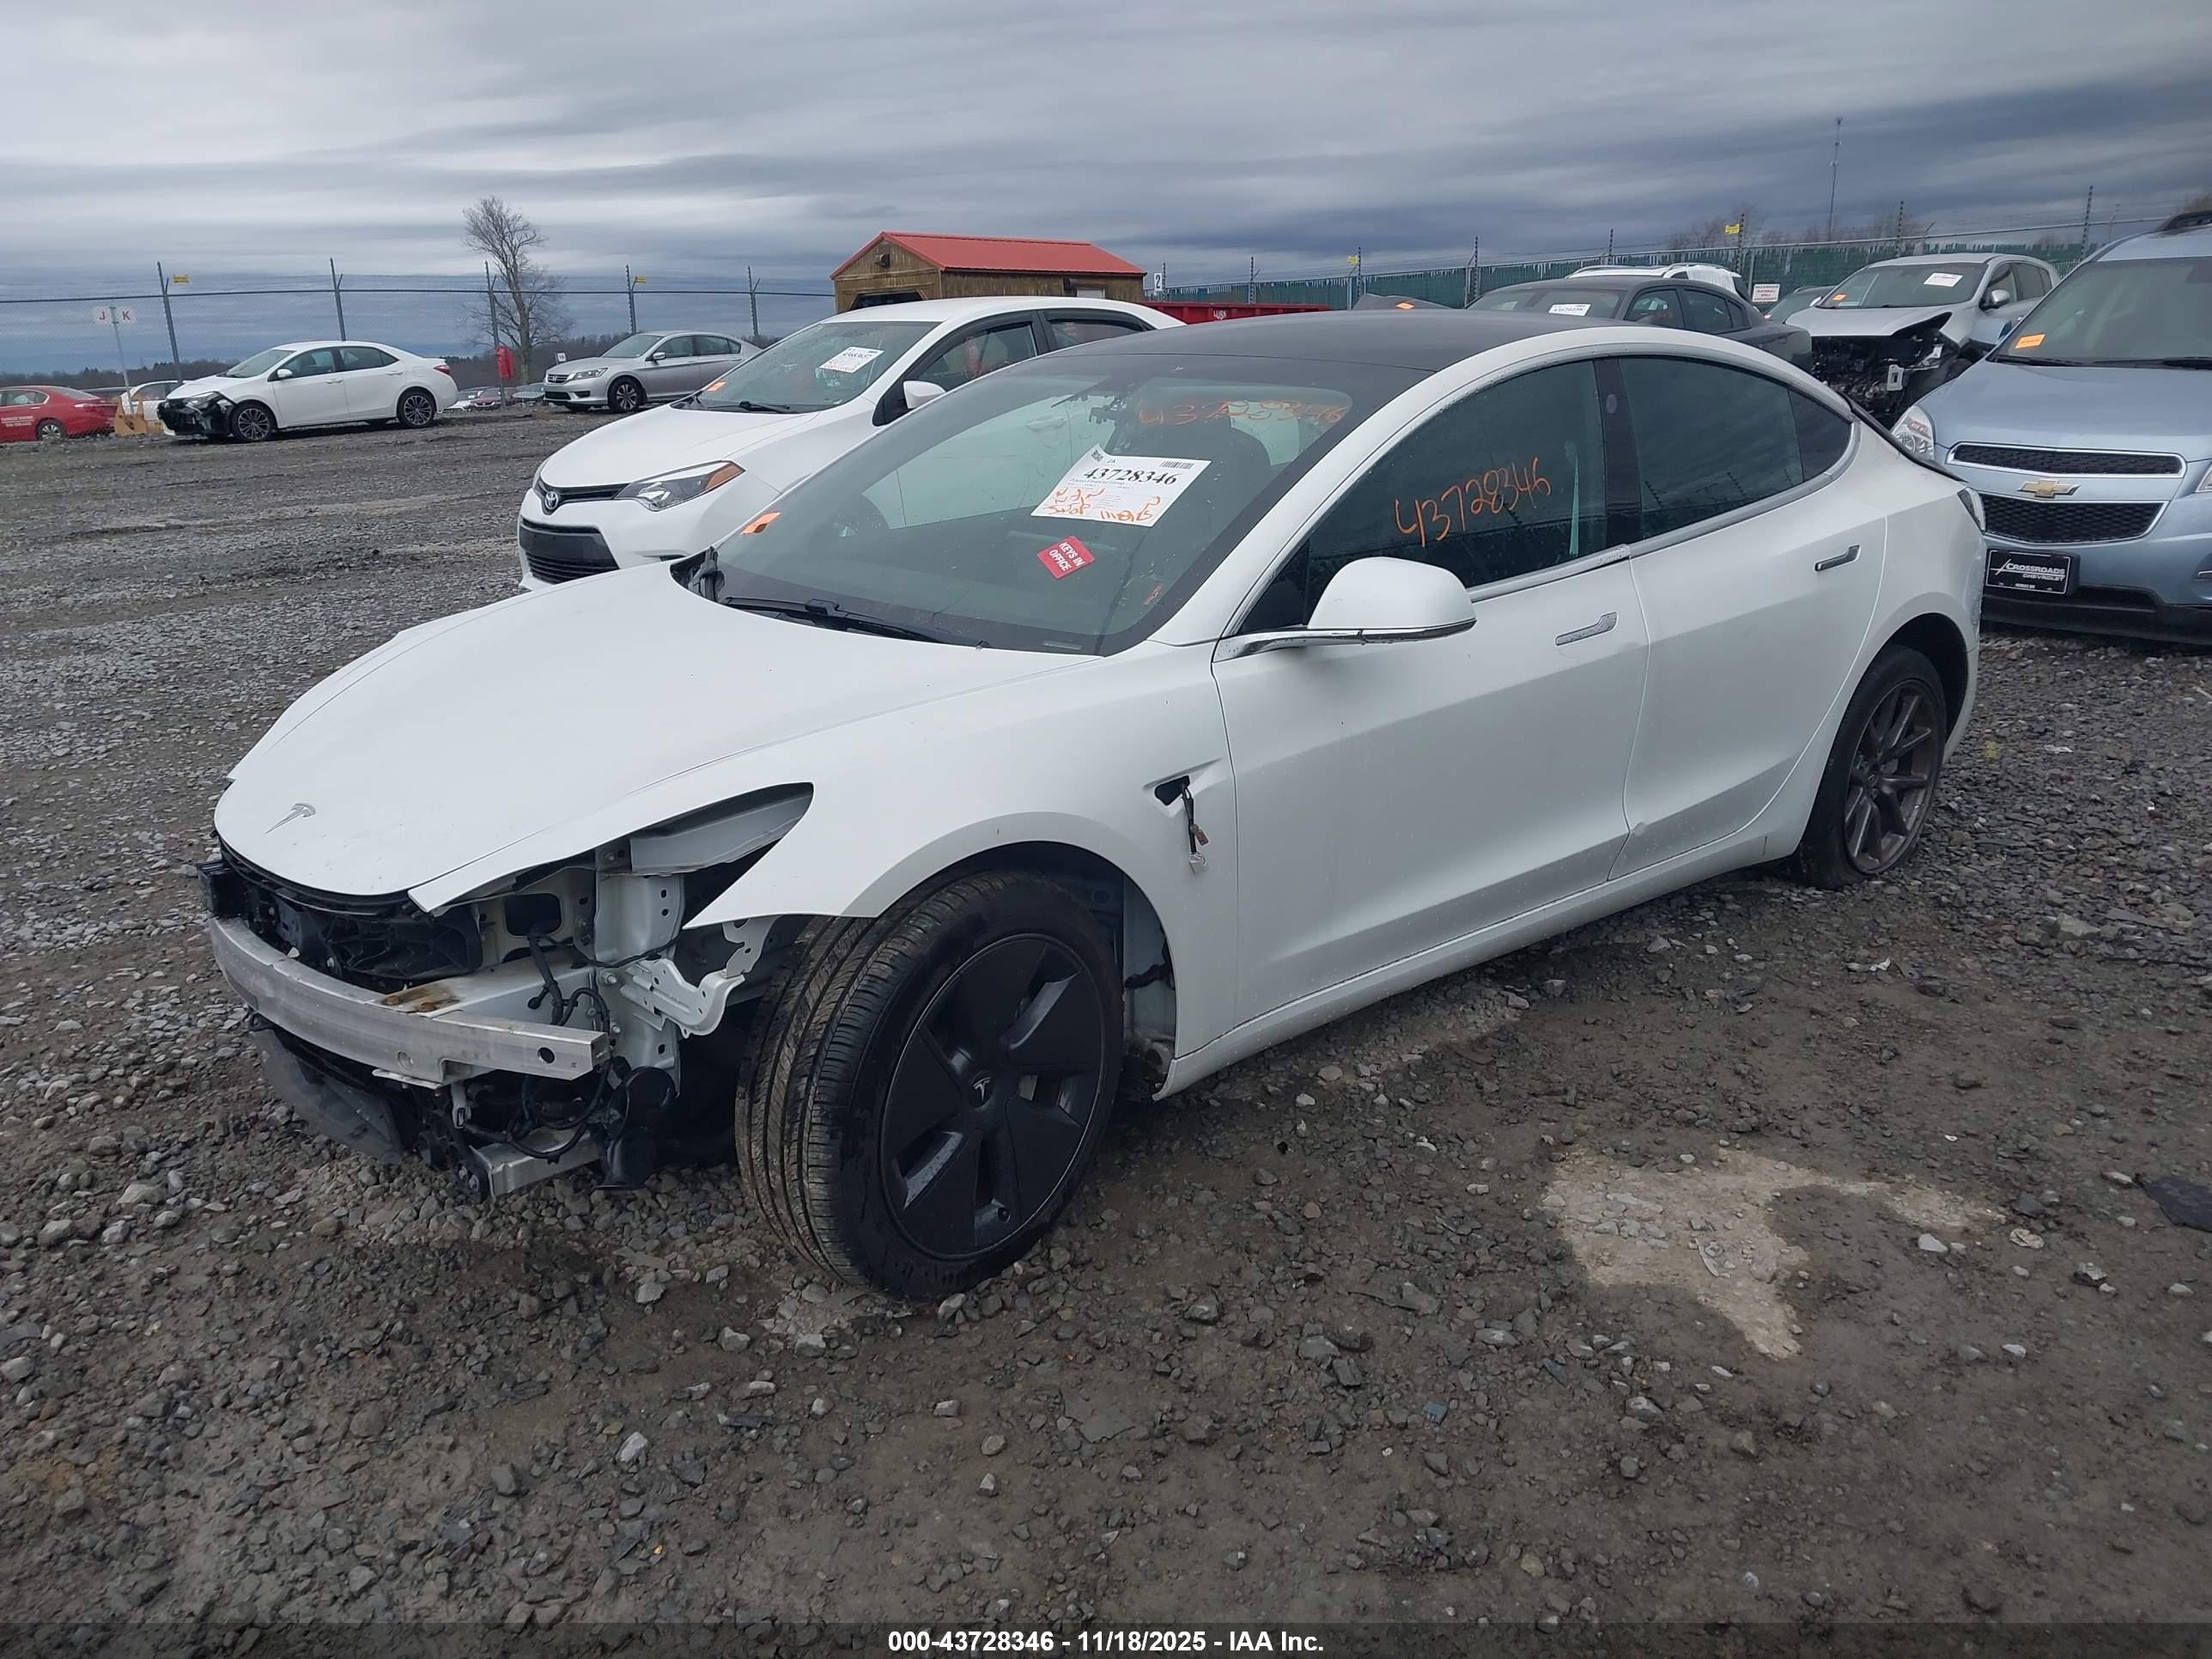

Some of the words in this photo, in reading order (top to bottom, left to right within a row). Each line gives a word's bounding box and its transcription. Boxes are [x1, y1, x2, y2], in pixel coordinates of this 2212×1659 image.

[1155, 274, 1161, 289] 2
[99, 311, 106, 320] J
[122, 310, 131, 320] K
[1084, 467, 1182, 487] 43728346
[1395, 456, 1552, 549] 43728346
[1048, 549, 1073, 572] OFFICE
[1058, 542, 1079, 559] KEYS
[1073, 556, 1086, 567] IN
[2005, 562, 2066, 574] CROSSROADS
